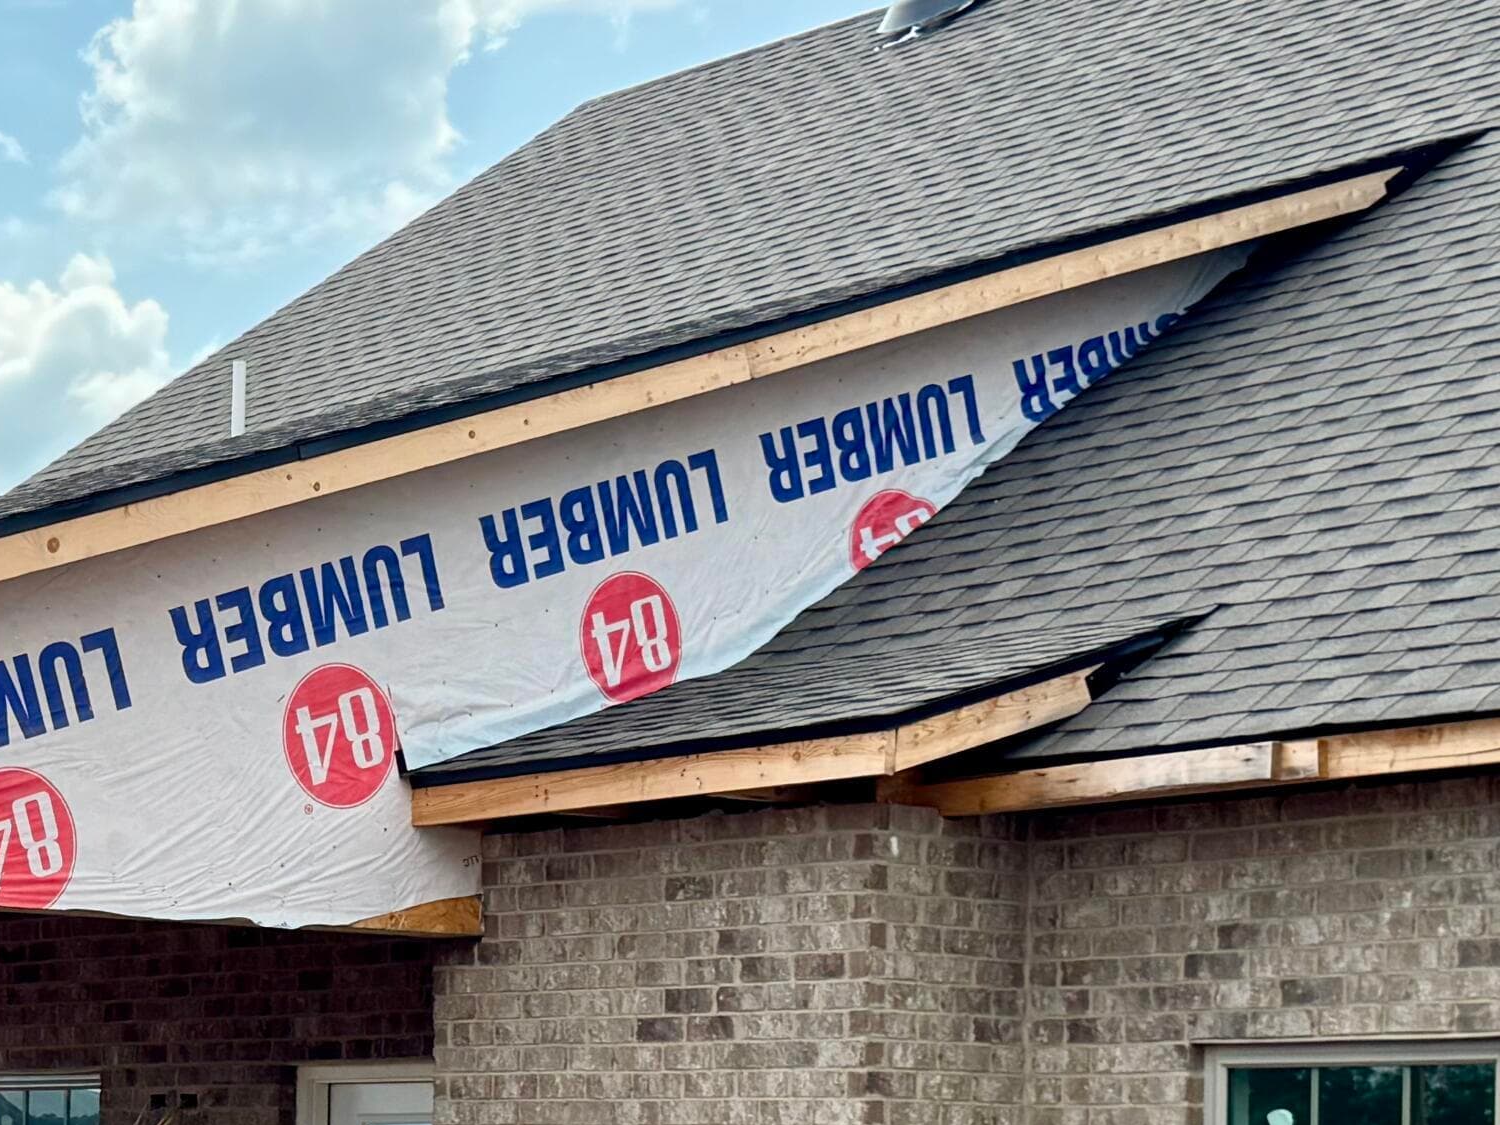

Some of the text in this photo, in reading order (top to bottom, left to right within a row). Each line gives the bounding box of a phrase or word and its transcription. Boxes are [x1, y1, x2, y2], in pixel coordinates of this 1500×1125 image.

[759, 374, 985, 503] LUMBER
[479, 449, 729, 588] LUMBER
[169, 533, 444, 684] LUMBER
[591, 594, 671, 688] 84
[295, 687, 384, 786] 84
